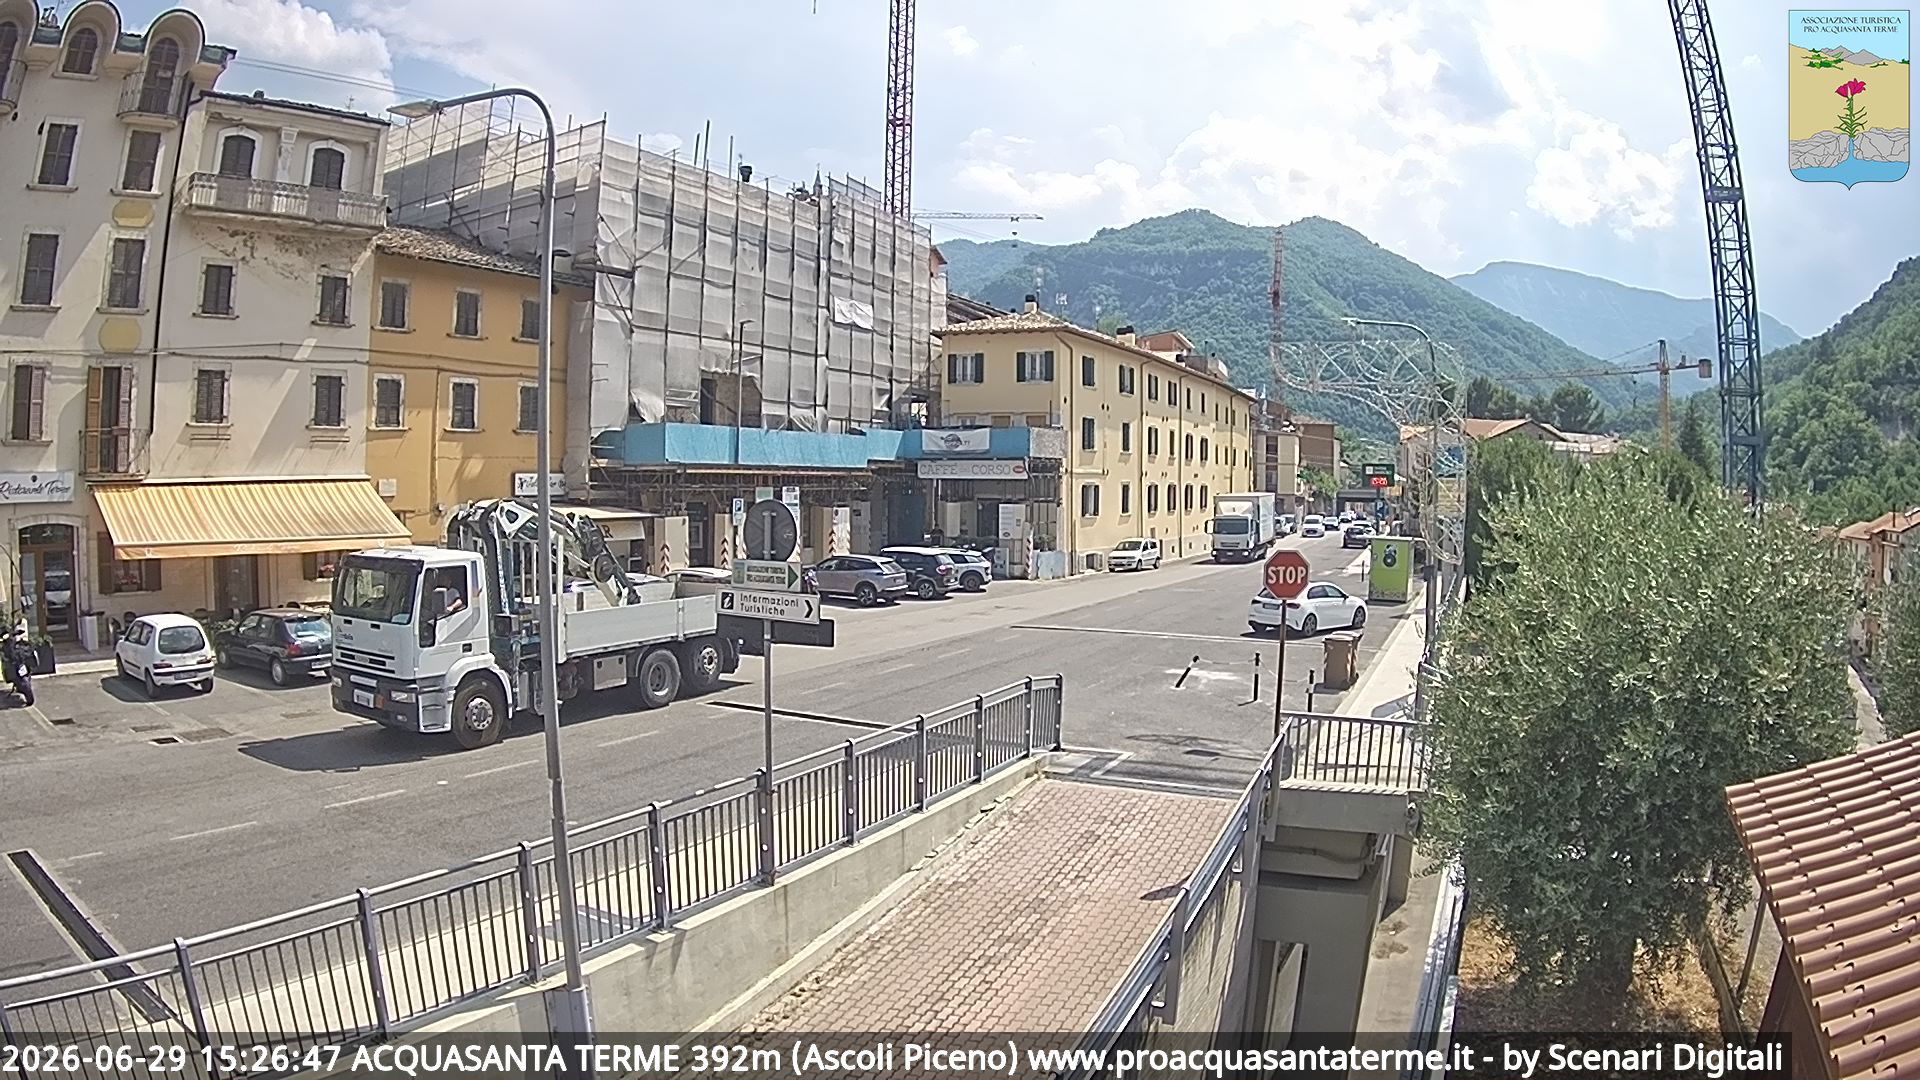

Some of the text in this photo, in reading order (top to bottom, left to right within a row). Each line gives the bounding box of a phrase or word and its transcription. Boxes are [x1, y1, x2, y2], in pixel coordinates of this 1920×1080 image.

[971, 463, 1011, 475] CORSO
[1267, 566, 1306, 584] STOP
[740, 592, 799, 607] Informazioni
[740, 602, 785, 616] Turistiche
